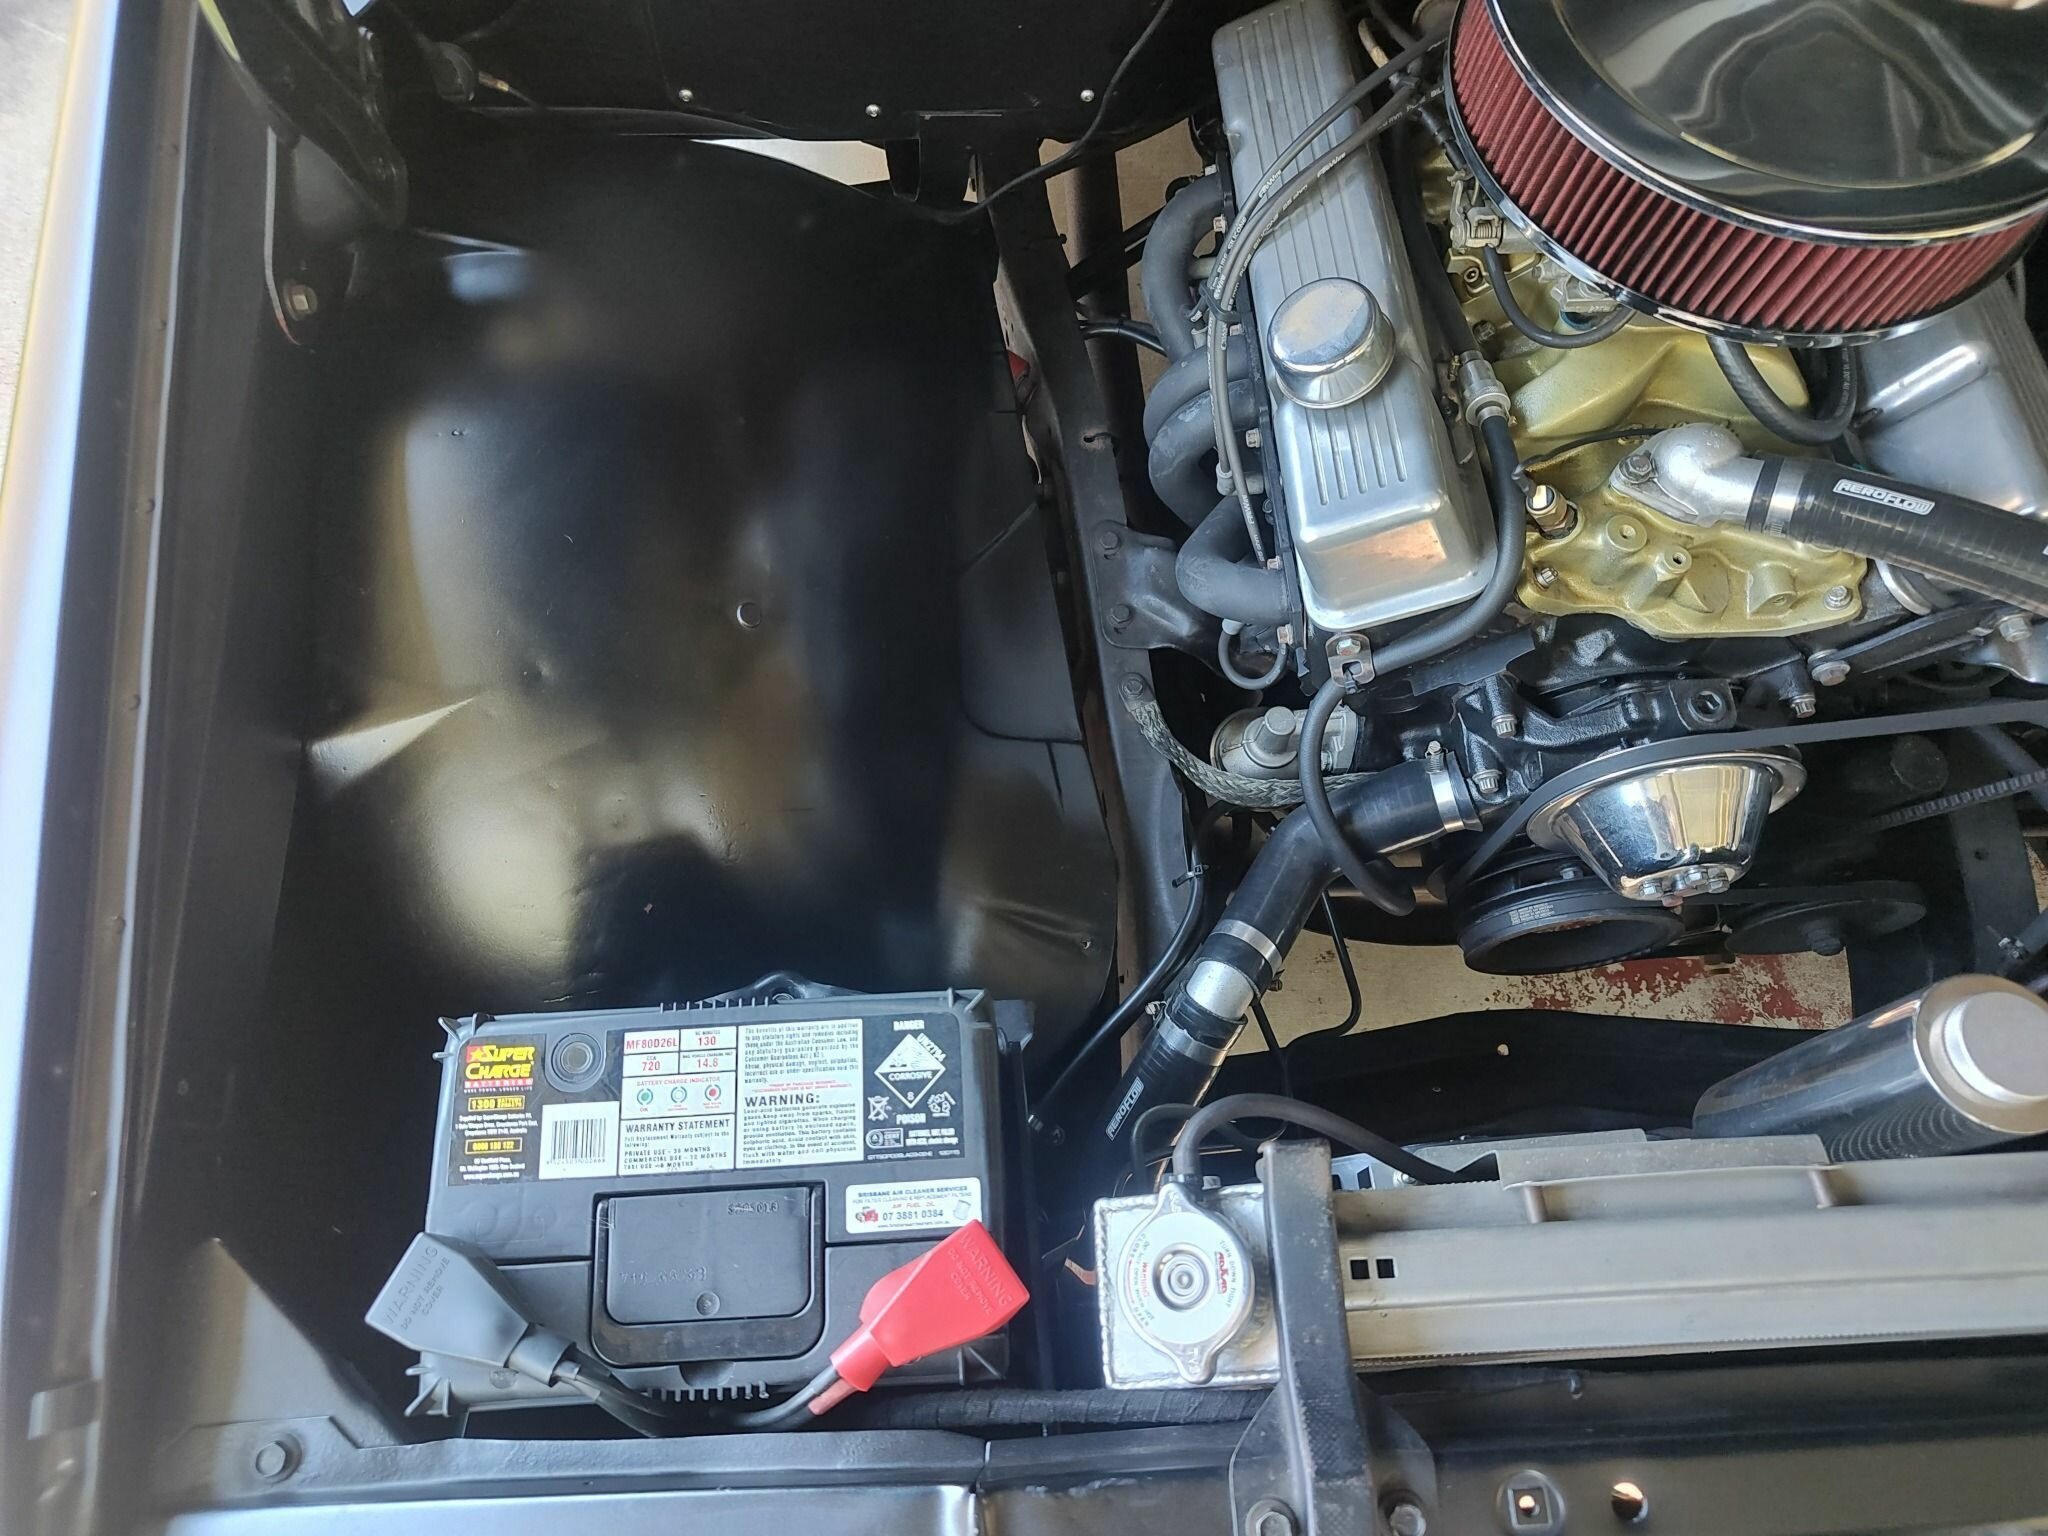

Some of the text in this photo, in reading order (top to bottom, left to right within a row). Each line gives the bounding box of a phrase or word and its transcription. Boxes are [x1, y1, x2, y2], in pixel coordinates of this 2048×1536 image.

[1836, 480, 1934, 514] AEROFLOW
[626, 1038, 677, 1050] MF80D26L
[698, 1036, 717, 1046] 130
[479, 1045, 535, 1062] SUPER
[642, 1061, 660, 1071] 720
[697, 1058, 719, 1068] 14.8
[465, 1063, 532, 1080] CHARGE
[888, 1071, 933, 1081] CORROSIVE
[745, 1093, 820, 1107] WARNING:
[907, 1092, 914, 1100] 8
[1107, 1080, 1143, 1138] AEROFLOW
[626, 1119, 730, 1133] WARRANTY STATEMENT
[882, 1212, 893, 1221] 07
[424, 1257, 450, 1294] REMOVE
[960, 1231, 1013, 1306] WARNING
[385, 1246, 438, 1324] WARNING
